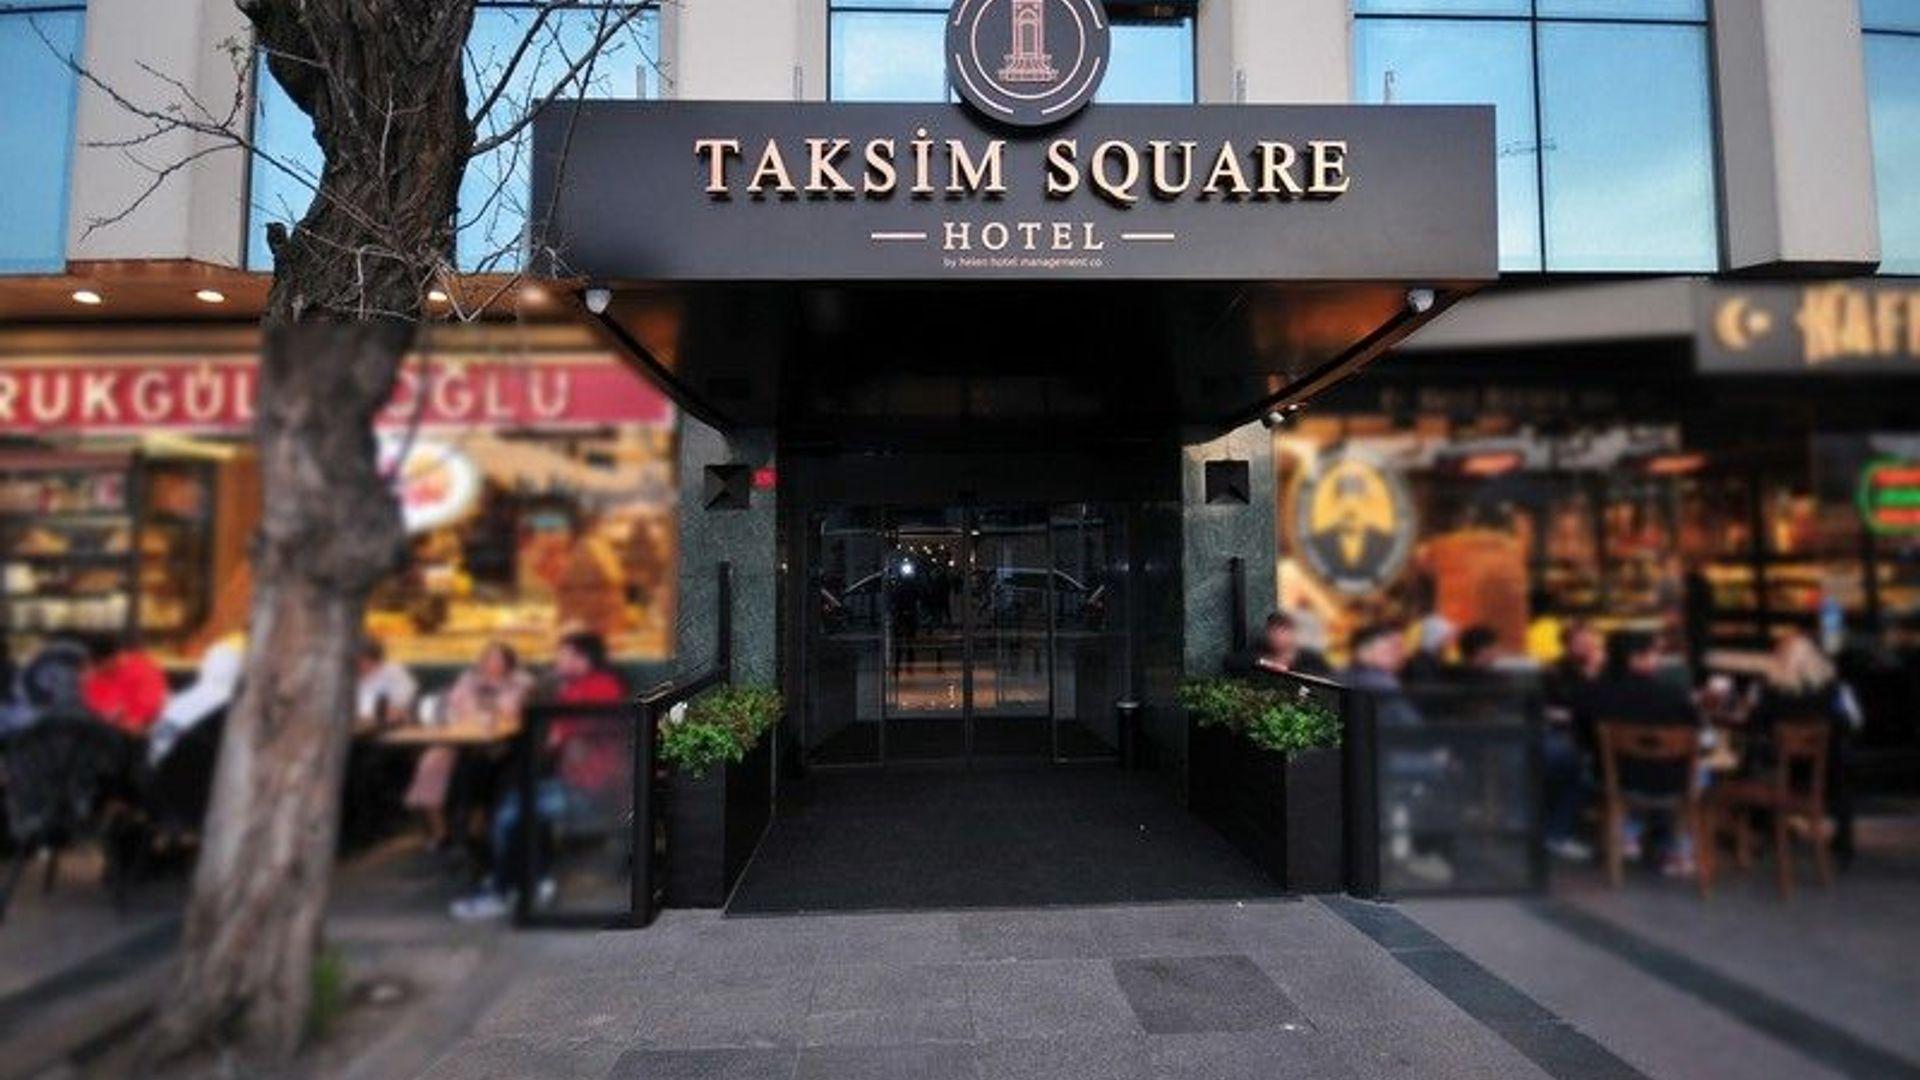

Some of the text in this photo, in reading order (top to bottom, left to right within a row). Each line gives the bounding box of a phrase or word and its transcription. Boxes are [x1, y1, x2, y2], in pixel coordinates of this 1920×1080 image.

[695, 127, 1351, 203] TAKSİM SQUARE
[942, 221, 1104, 251] HOTEL
[943, 256, 957, 269] by
[990, 255, 1017, 267] hotel
[1019, 255, 1088, 269] management
